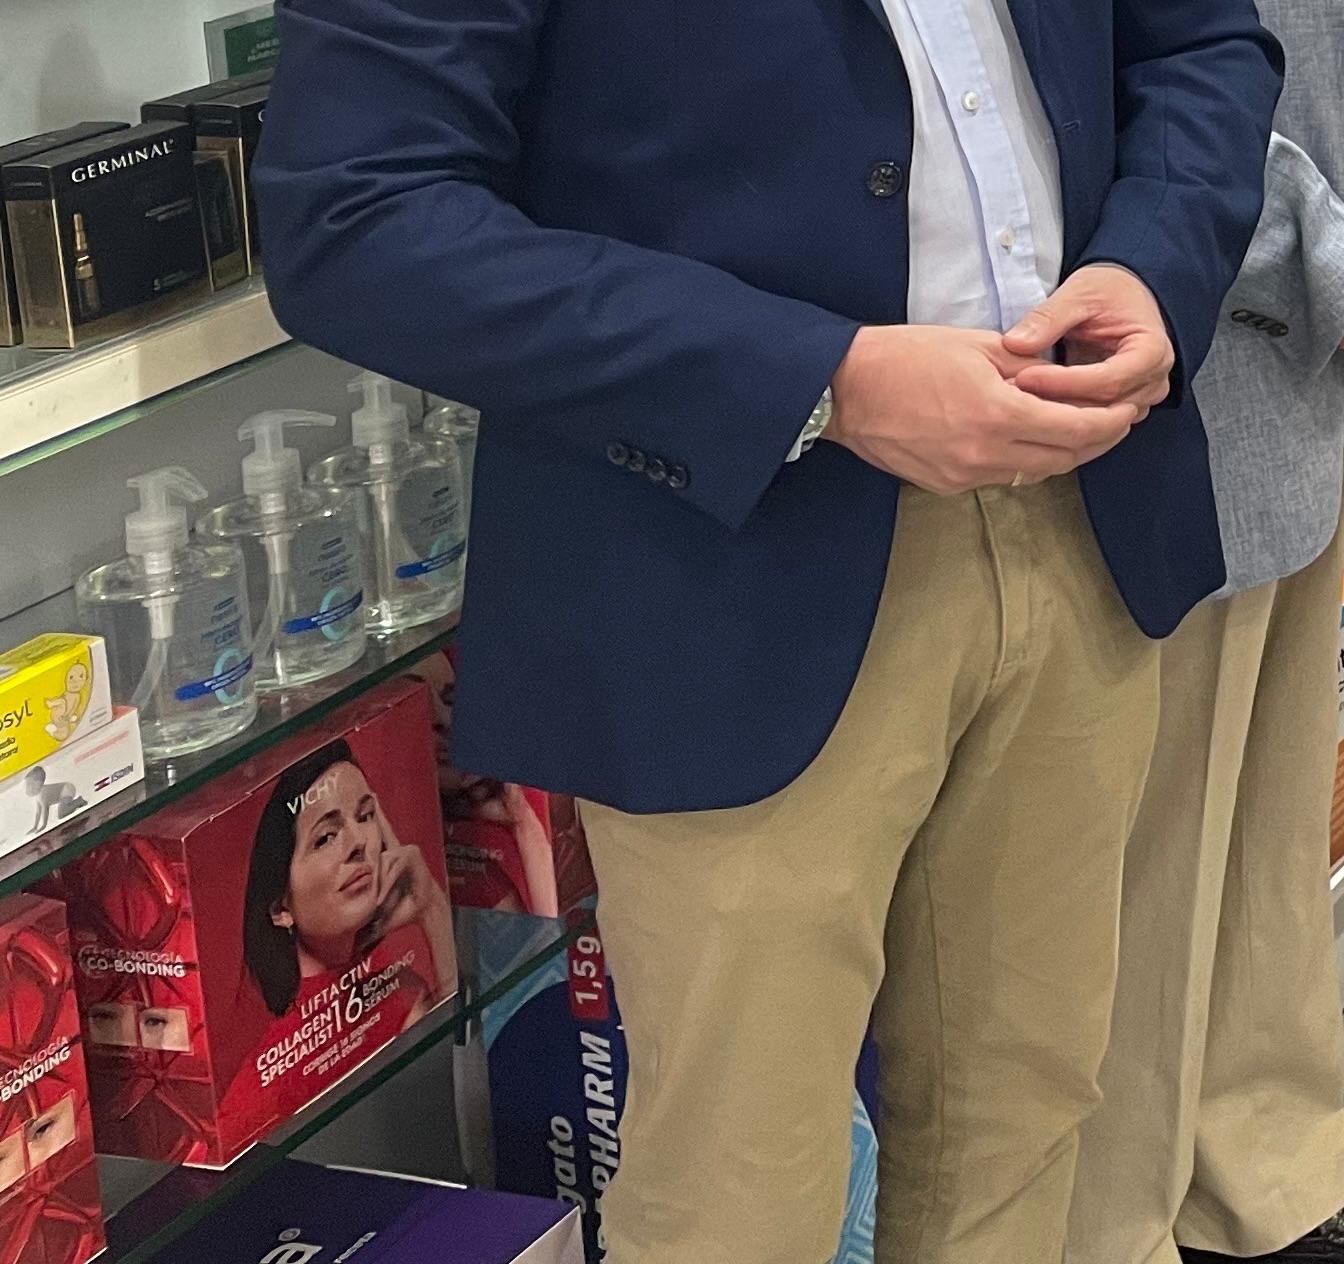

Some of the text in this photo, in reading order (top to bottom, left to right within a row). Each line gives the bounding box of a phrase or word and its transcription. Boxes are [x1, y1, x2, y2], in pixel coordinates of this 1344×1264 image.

[71, 140, 171, 184] GERMINAL
[286, 772, 340, 816] VICHY
[300, 955, 373, 1021] LIFTACTIV
[256, 1007, 333, 1072] COLLAGEN
[330, 986, 363, 1034] 16
[260, 1024, 334, 1088] SPECIALIST
